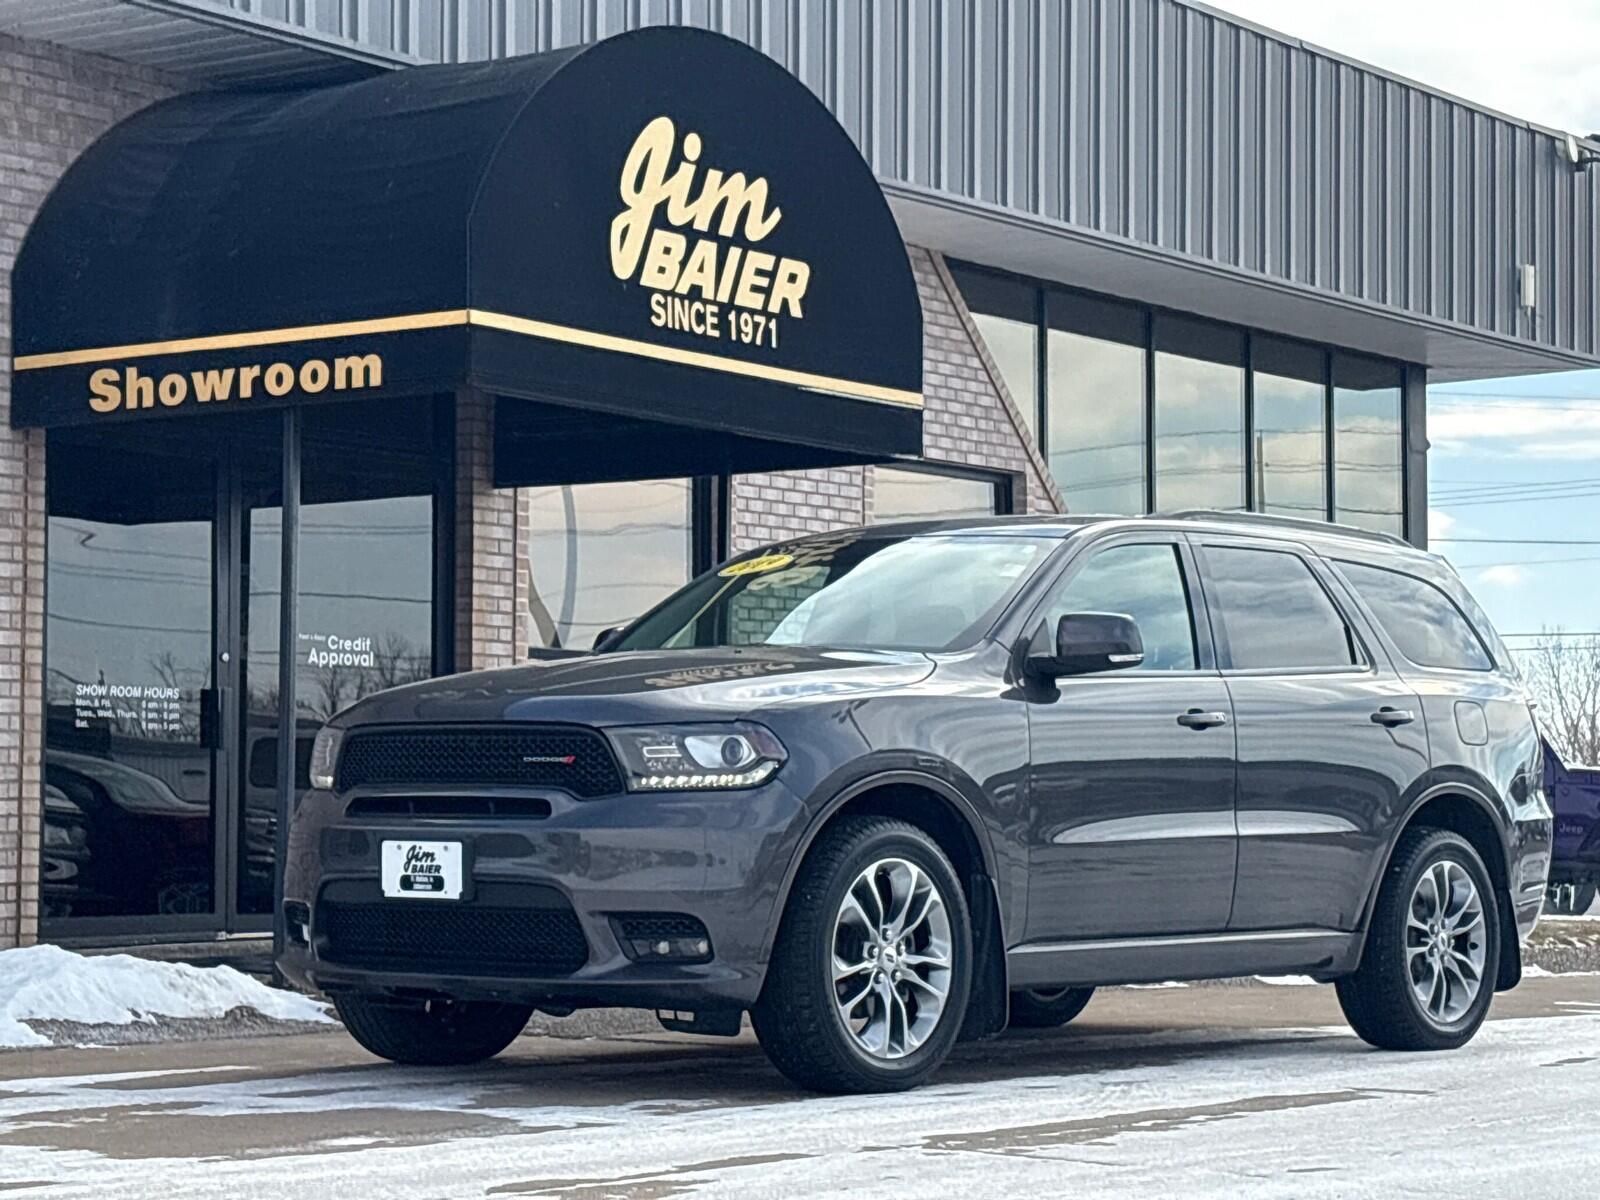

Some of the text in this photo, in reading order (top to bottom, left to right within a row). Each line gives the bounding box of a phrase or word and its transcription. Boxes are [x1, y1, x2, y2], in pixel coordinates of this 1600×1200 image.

[610, 116, 782, 280] Jim
[639, 228, 811, 319] BAIER
[650, 292, 778, 349] SINCE 1971
[89, 353, 382, 413] Showroom
[327, 635, 371, 652] Credit
[308, 647, 374, 668] Approval
[76, 684, 180, 699] SHOW ROOM HOURS
[1559, 823, 1584, 835] Jeep
[403, 844, 436, 873] Jim
[411, 864, 442, 875] BAIER
